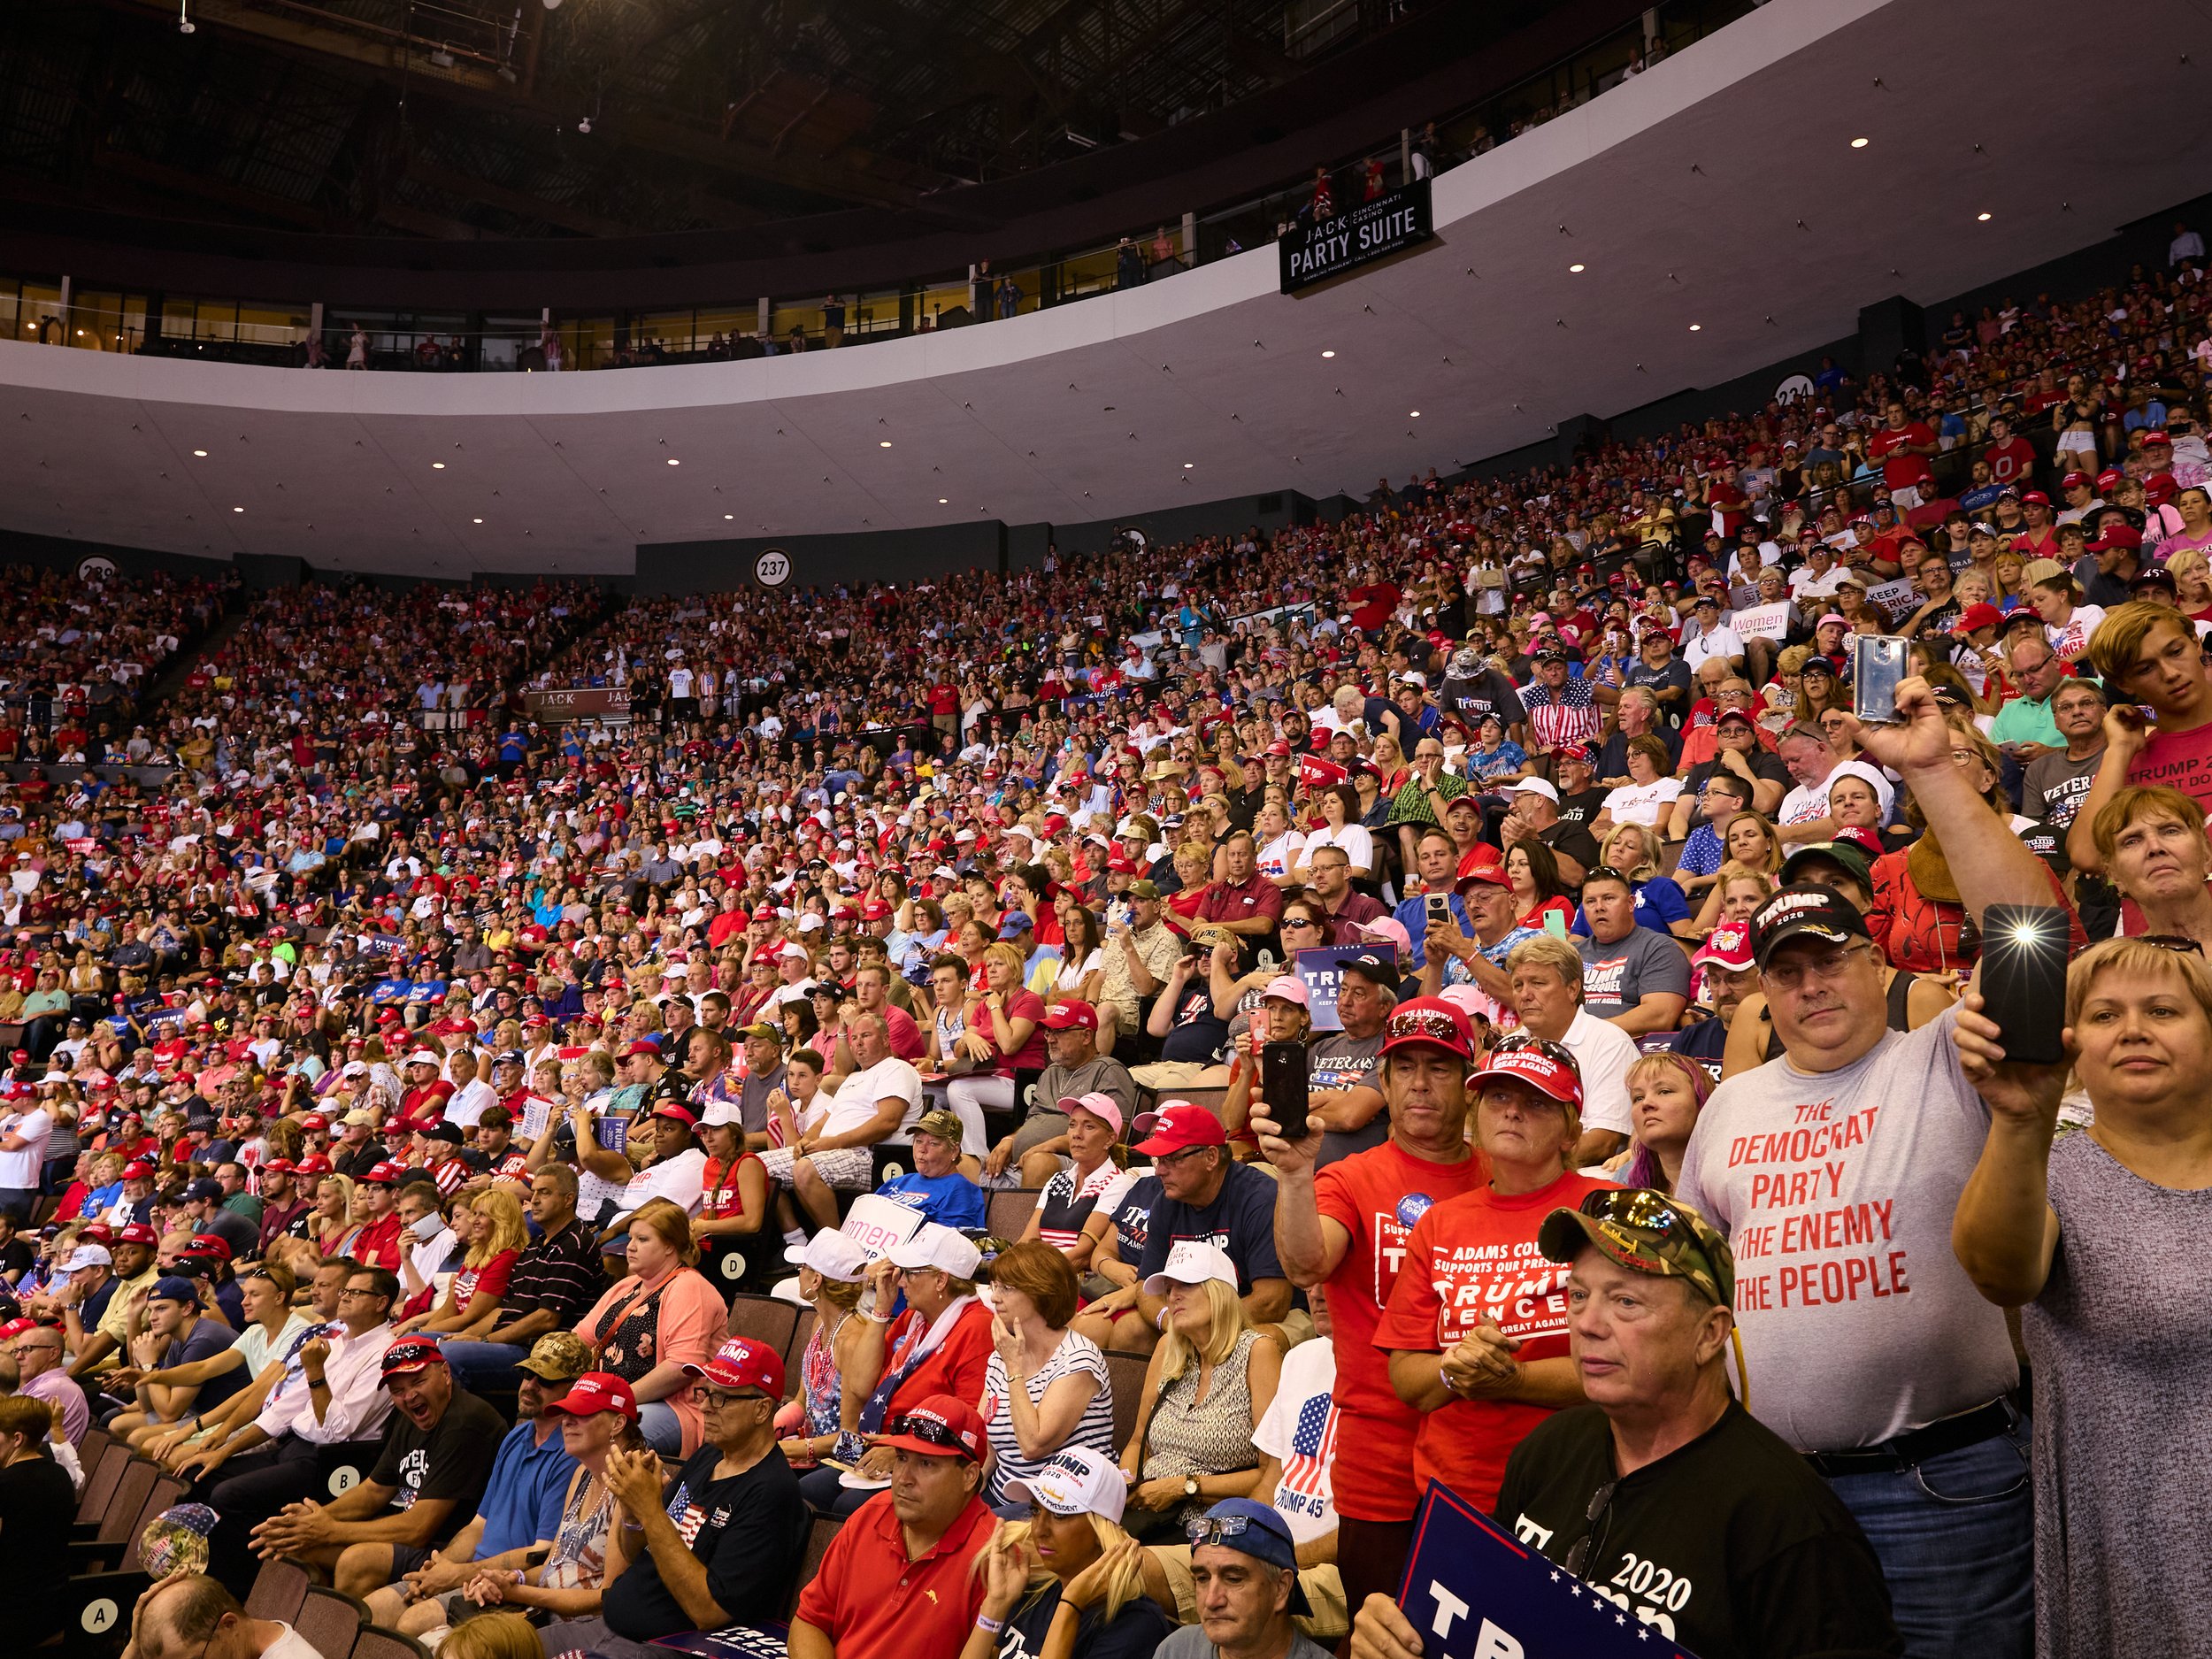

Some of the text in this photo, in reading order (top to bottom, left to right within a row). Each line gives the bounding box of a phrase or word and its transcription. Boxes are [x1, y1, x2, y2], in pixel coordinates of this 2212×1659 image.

[1353, 194, 1402, 218] CINCINNATI
[1353, 208, 1384, 225] CASINO
[1290, 206, 1416, 278] PARTY SUITE
[1125, 537, 1141, 555] 36
[760, 560, 786, 577] 237
[1869, 587, 1900, 601] KEEP
[1881, 591, 1923, 610] ERICA
[1734, 613, 1783, 632] Women
[1753, 625, 1778, 634] TRUMP
[2128, 758, 2199, 784] TRUMP
[1756, 893, 1829, 929] TRUMP
[1776, 910, 1805, 926] 2020
[1263, 953, 1269, 964] H
[1583, 964, 1625, 984] UMP
[1514, 1052, 1558, 1073] AMERICA
[1518, 1061, 1553, 1077] AGAIN
[1794, 1097, 1834, 1125] THE
[1728, 1106, 1878, 1169] DEMOCRAT
[1750, 1161, 1846, 1210] PARTY
[1740, 1199, 1893, 1261] THE ENEMY
[1453, 1244, 1509, 1261] ADAMS
[730, 1260, 738, 1272] D
[1433, 1258, 1493, 1274] SUPPORTS
[1496, 1260, 1520, 1273] OUR
[1432, 1270, 1571, 1307] TRUMP
[1735, 1250, 1910, 1312] THE PEOPLE
[1443, 1294, 1567, 1327] PENCE
[1501, 1322, 1532, 1334] GREAT
[916, 1408, 949, 1426] AMERICA
[340, 1474, 349, 1489] B
[1046, 1498, 1079, 1512] PRESIDENT
[1275, 1488, 1325, 1518] TRUMP 45
[1610, 1551, 1692, 1613] 2020
[93, 1607, 106, 1624] A
